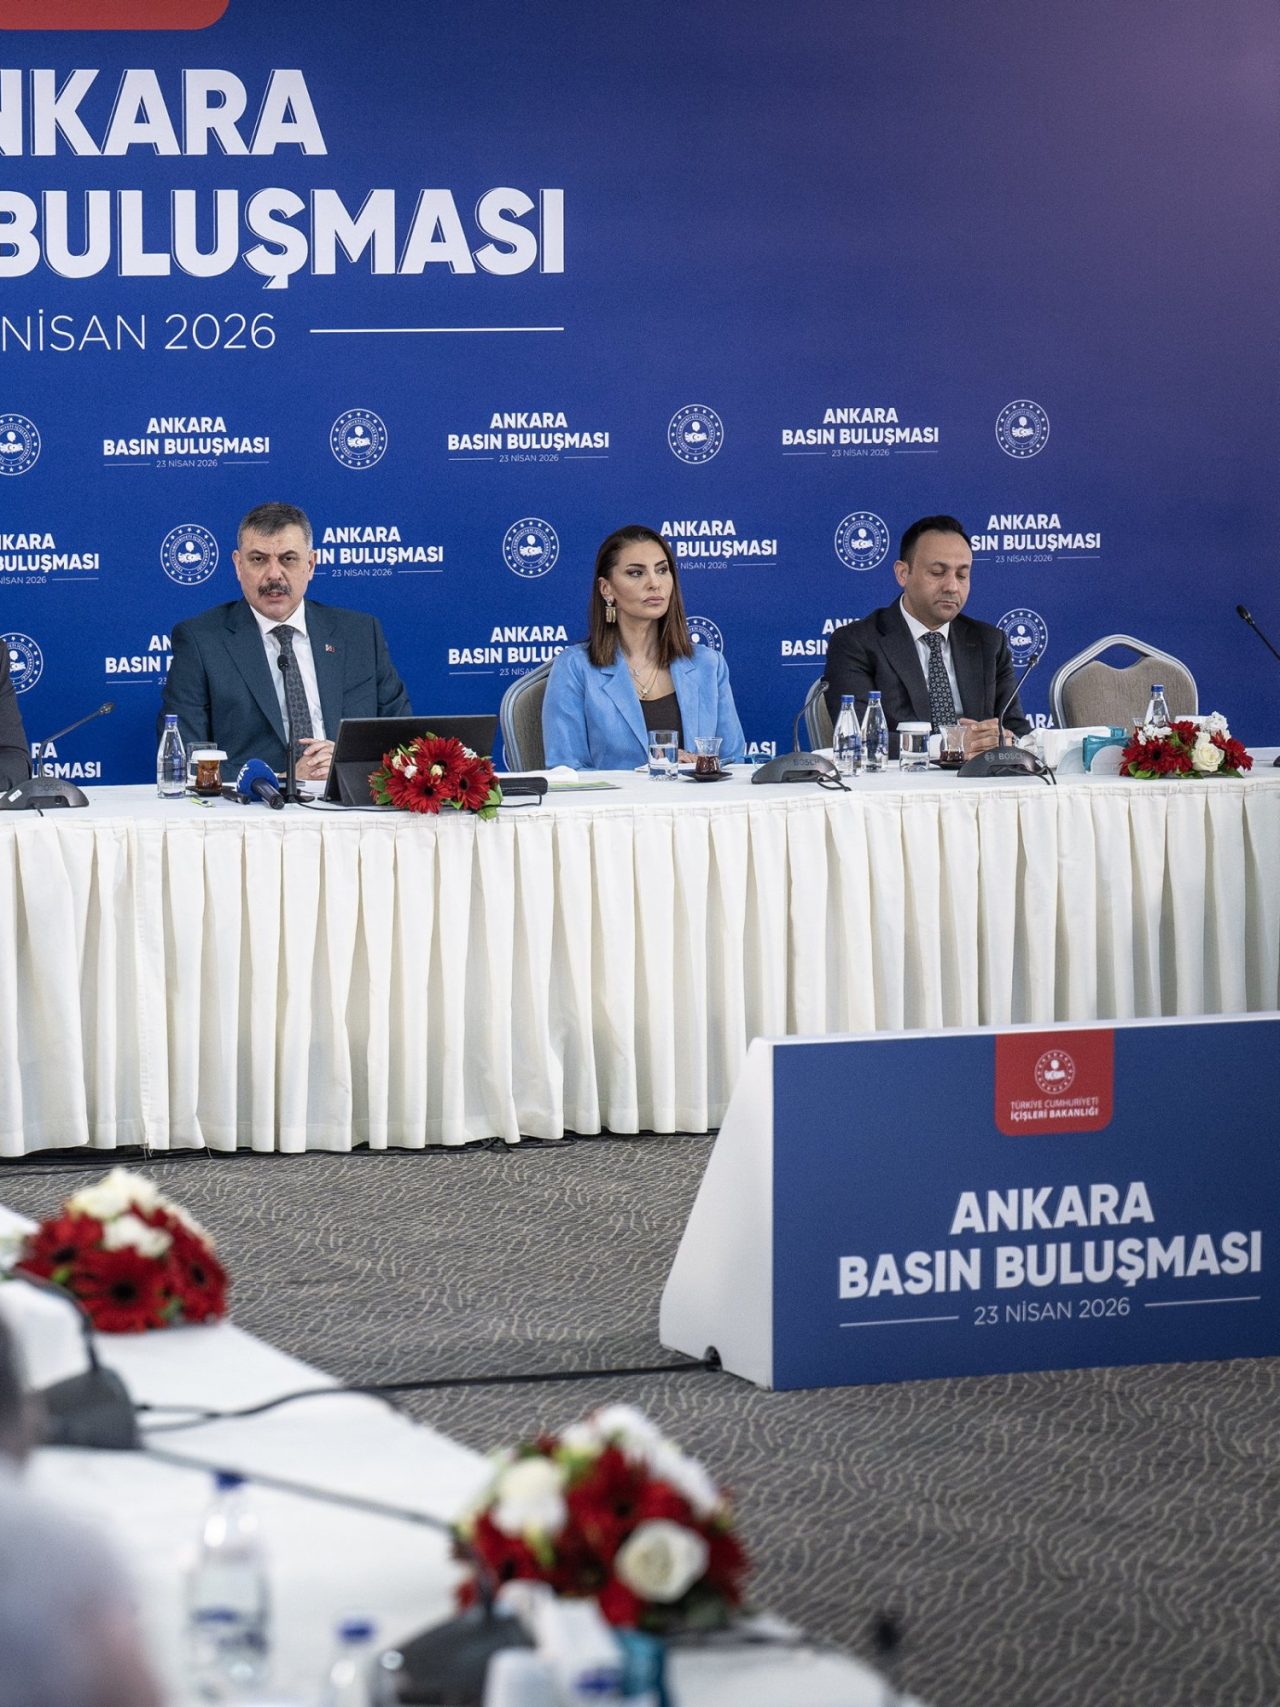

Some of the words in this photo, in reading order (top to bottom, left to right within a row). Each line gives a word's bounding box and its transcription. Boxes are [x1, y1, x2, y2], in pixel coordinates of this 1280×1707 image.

[3, 309, 145, 351] NİSAN
[165, 313, 275, 349] 2026
[490, 412, 567, 428] ANKARA
[823, 408, 898, 424] ANKARA
[147, 417, 226, 433] ANKARA
[448, 434, 502, 450] BASIN
[507, 432, 609, 451] BULUŞMASI
[783, 429, 834, 445] BASIN
[840, 427, 938, 445] BULUŞMASI
[104, 439, 159, 455] BASIN
[165, 437, 269, 456] BULUŞMASI
[843, 448, 868, 456] NİSAN
[156, 460, 166, 468] 23
[169, 459, 195, 467] NİSAN
[197, 459, 217, 467] 2026
[511, 454, 537, 462] NİSAN
[660, 520, 736, 536] ANKARA
[987, 514, 1061, 530] ANKARA
[323, 527, 401, 543] ANKARA
[970, 535, 998, 551] SIN
[1004, 533, 1100, 551] BULUŞMASI
[340, 546, 443, 565] BULUŞMASI
[677, 540, 776, 558] BULUŞMASI
[995, 555, 1005, 563] 23
[26, 576, 47, 584] 2026
[372, 568, 392, 576] 2026
[491, 626, 568, 642] ANKARA
[449, 648, 502, 664] BASIN
[106, 656, 160, 673] BASIN
[500, 668, 509, 676] 23
[950, 1182, 1154, 1234] ANKARA
[840, 1248, 980, 1298] BASIN
[996, 1231, 1261, 1288] BULUŞMASI
[974, 1306, 998, 1325] 23
[1006, 1301, 1071, 1322] NİSAN
[1079, 1297, 1130, 1318] 2026
